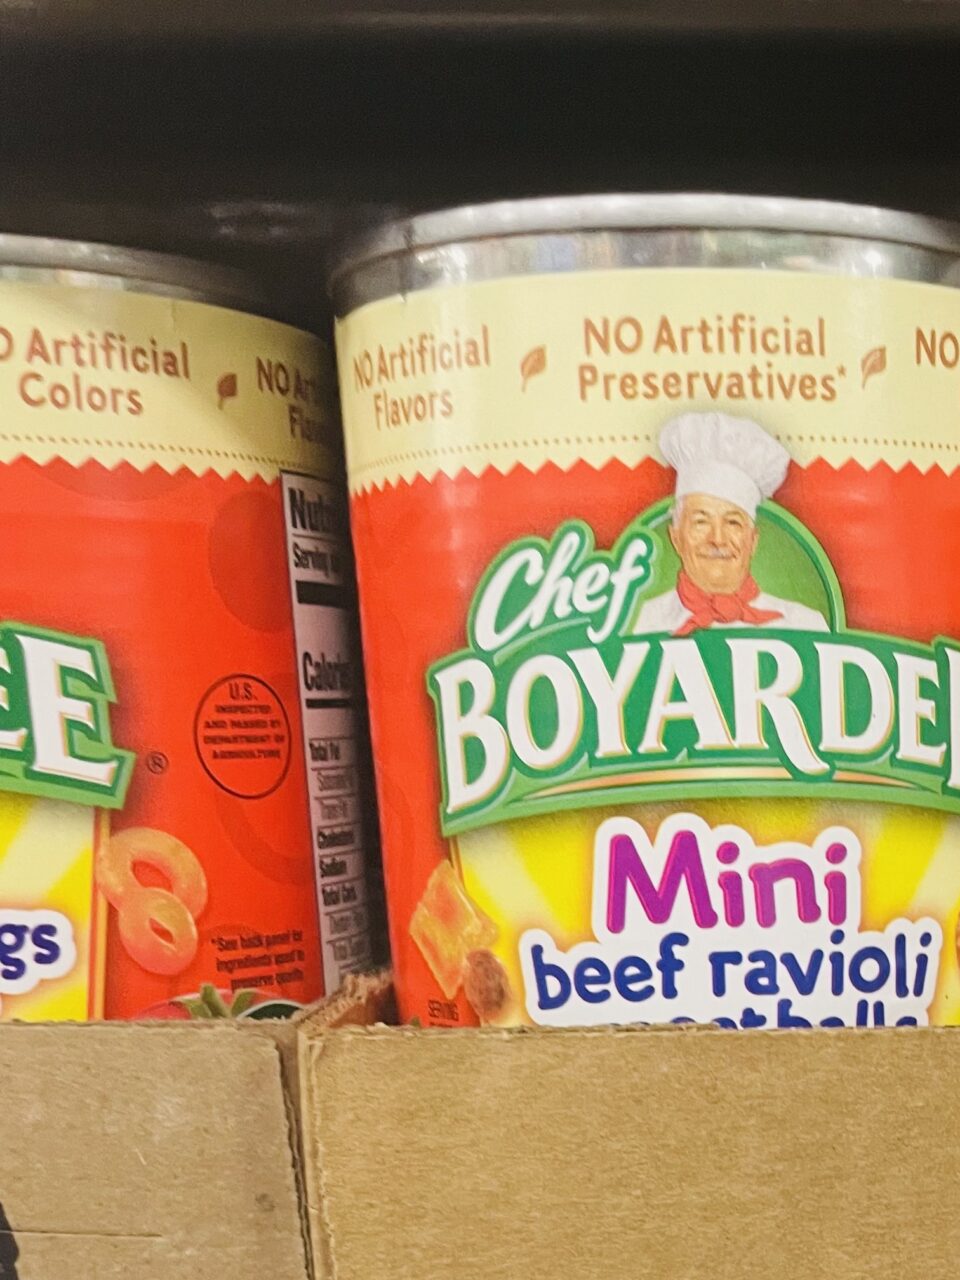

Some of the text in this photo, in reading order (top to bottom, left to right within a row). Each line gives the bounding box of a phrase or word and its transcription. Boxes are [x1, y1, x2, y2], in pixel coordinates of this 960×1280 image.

[26, 327, 190, 379] Artificial
[352, 350, 375, 389] NO
[375, 325, 491, 380] Artificial
[583, 313, 826, 357] NO Artificial
[915, 329, 960, 370] NO
[18, 372, 143, 415] Colors
[256, 356, 290, 396] NO
[373, 389, 454, 432] Flavors
[474, 528, 650, 652] Chef
[606, 829, 848, 934] Mini
[529, 929, 932, 1010] beef ravioli
